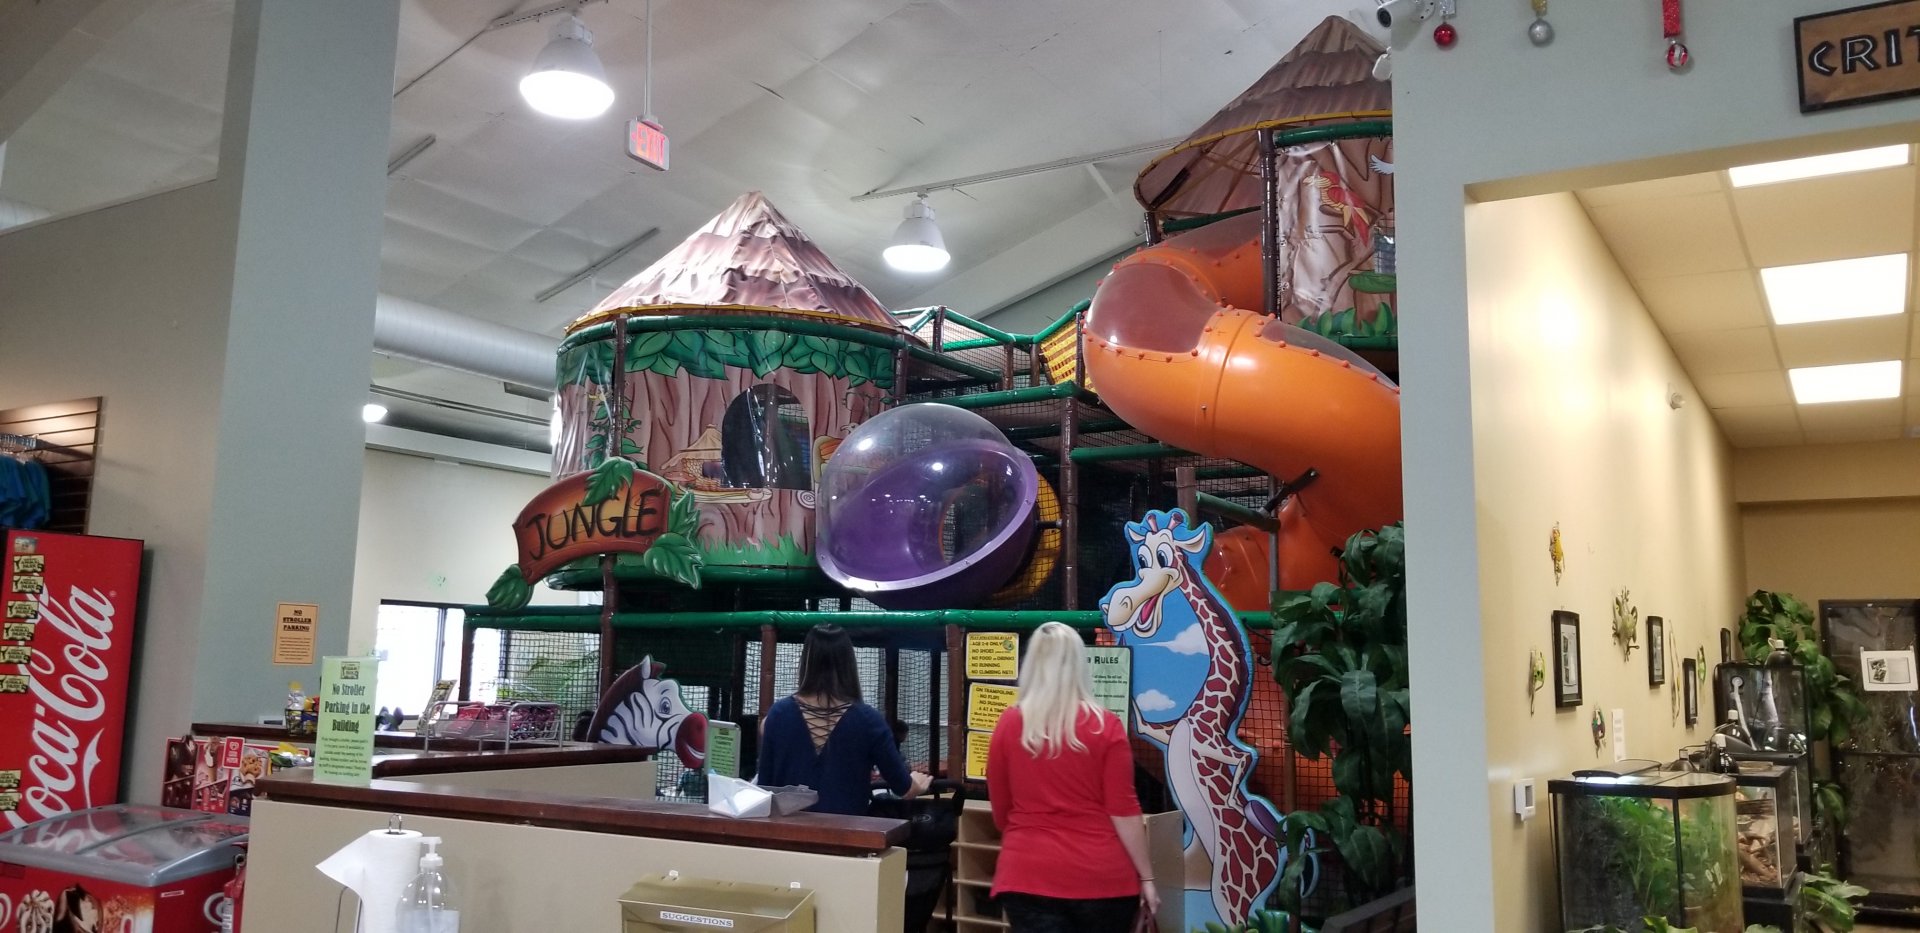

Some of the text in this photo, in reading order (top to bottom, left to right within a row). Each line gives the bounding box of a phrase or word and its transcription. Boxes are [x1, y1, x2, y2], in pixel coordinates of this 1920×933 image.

[637, 123, 665, 164] EXIT
[525, 486, 663, 560] JUNGLE
[1094, 656, 1118, 664] RULES
[332, 684, 366, 696] No Stroller
[4, 582, 115, 829] oca-Cola
[324, 701, 370, 716] Parking in the
[332, 720, 360, 734] Building
[662, 912, 732, 926] SUGGESTIONS
